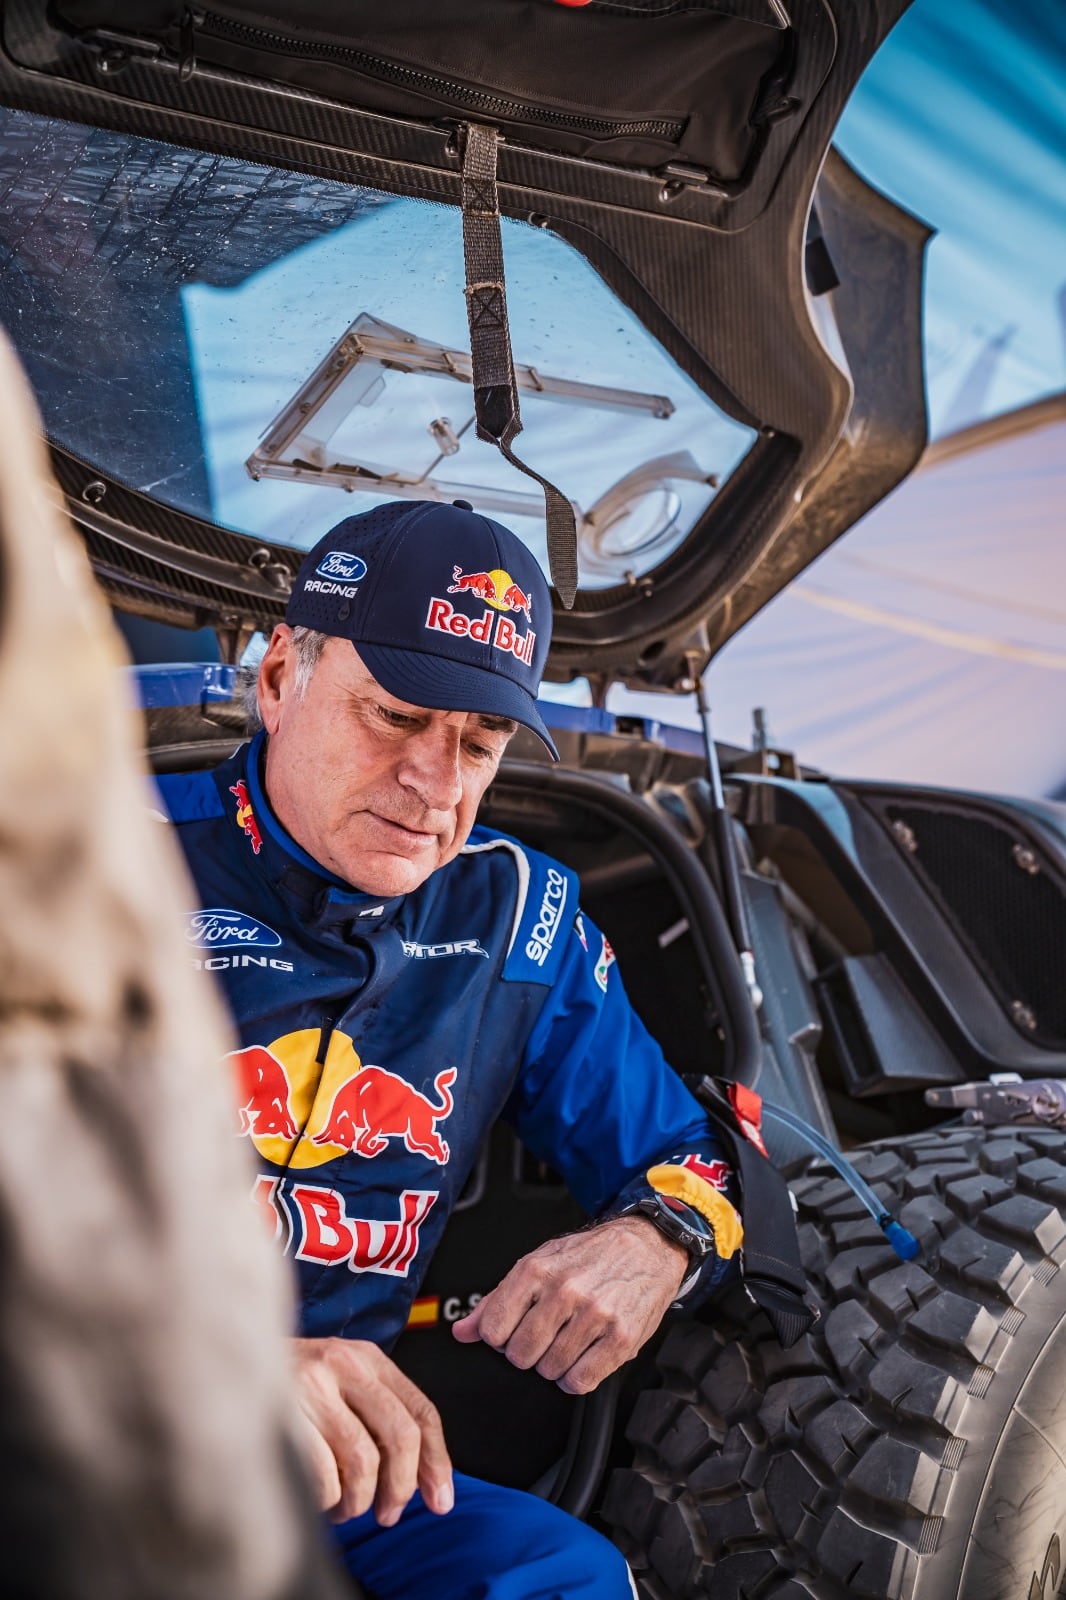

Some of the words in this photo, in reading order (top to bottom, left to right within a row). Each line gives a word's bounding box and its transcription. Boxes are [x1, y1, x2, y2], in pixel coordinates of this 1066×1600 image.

[304, 580, 359, 599] RACING
[322, 554, 354, 578] Ford
[425, 597, 494, 645] Red
[493, 615, 536, 666] Bull
[184, 914, 259, 941] Ford
[525, 869, 567, 966] sparco
[292, 1184, 439, 1278] Bull
